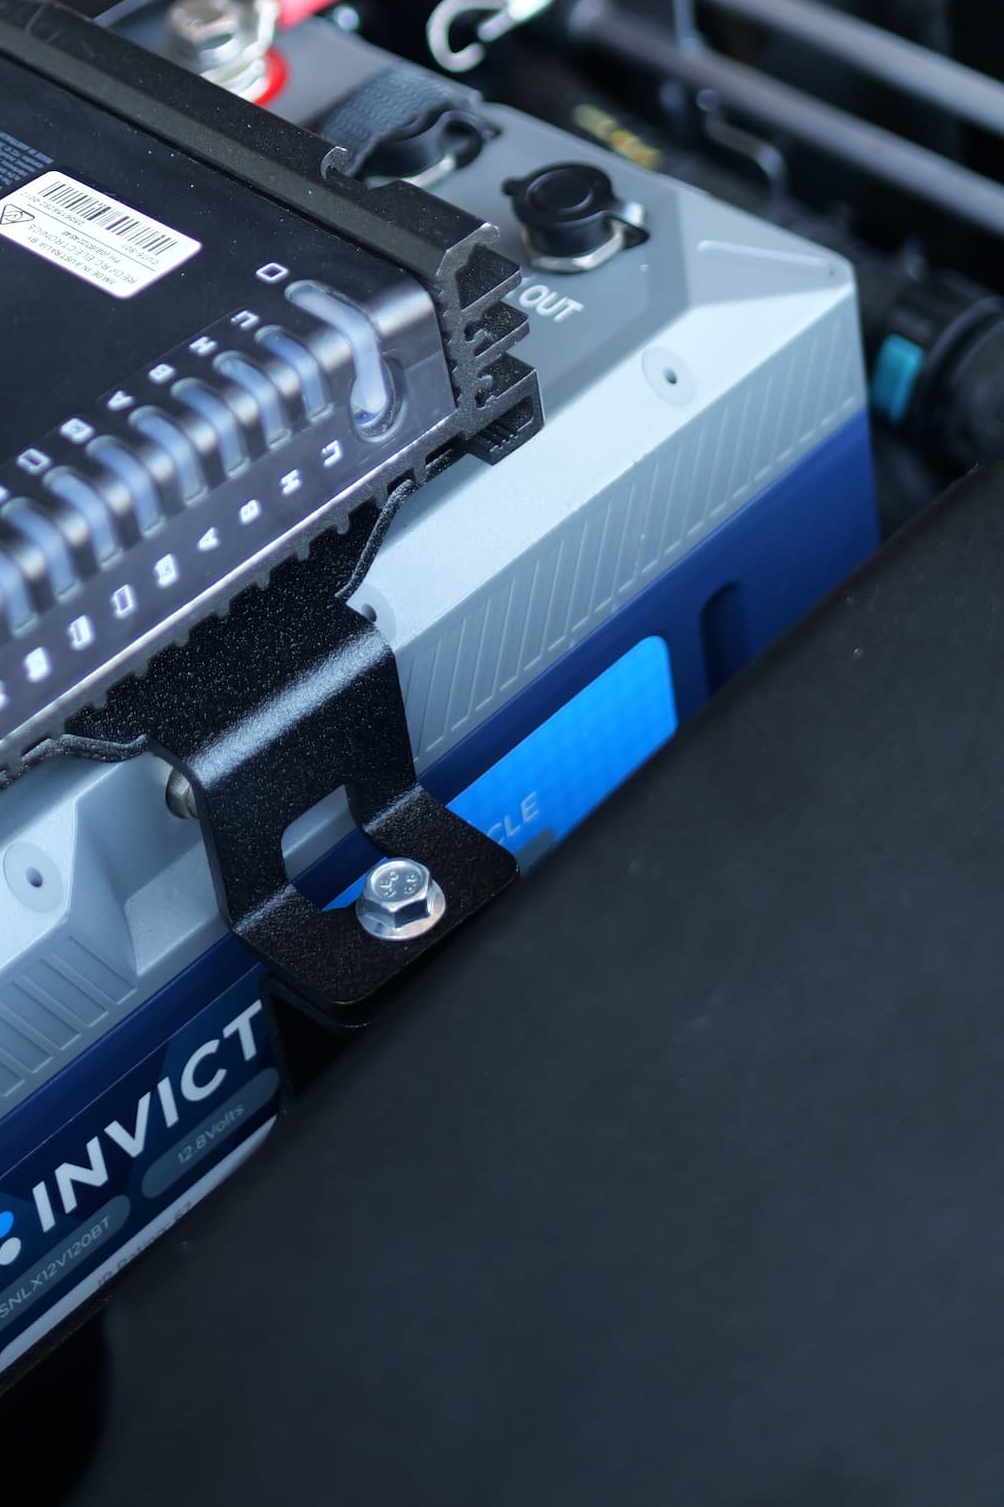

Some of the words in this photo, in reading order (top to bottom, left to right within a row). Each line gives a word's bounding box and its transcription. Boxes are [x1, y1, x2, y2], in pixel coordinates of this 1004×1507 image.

[26, 223, 94, 262] ELECTRONICS
[37, 241, 83, 267] AUSTRALIA
[519, 280, 584, 323] OUT
[148, 363, 176, 384] B
[106, 390, 134, 411] A
[198, 526, 221, 552] A
[31, 999, 263, 1233] INVICT
